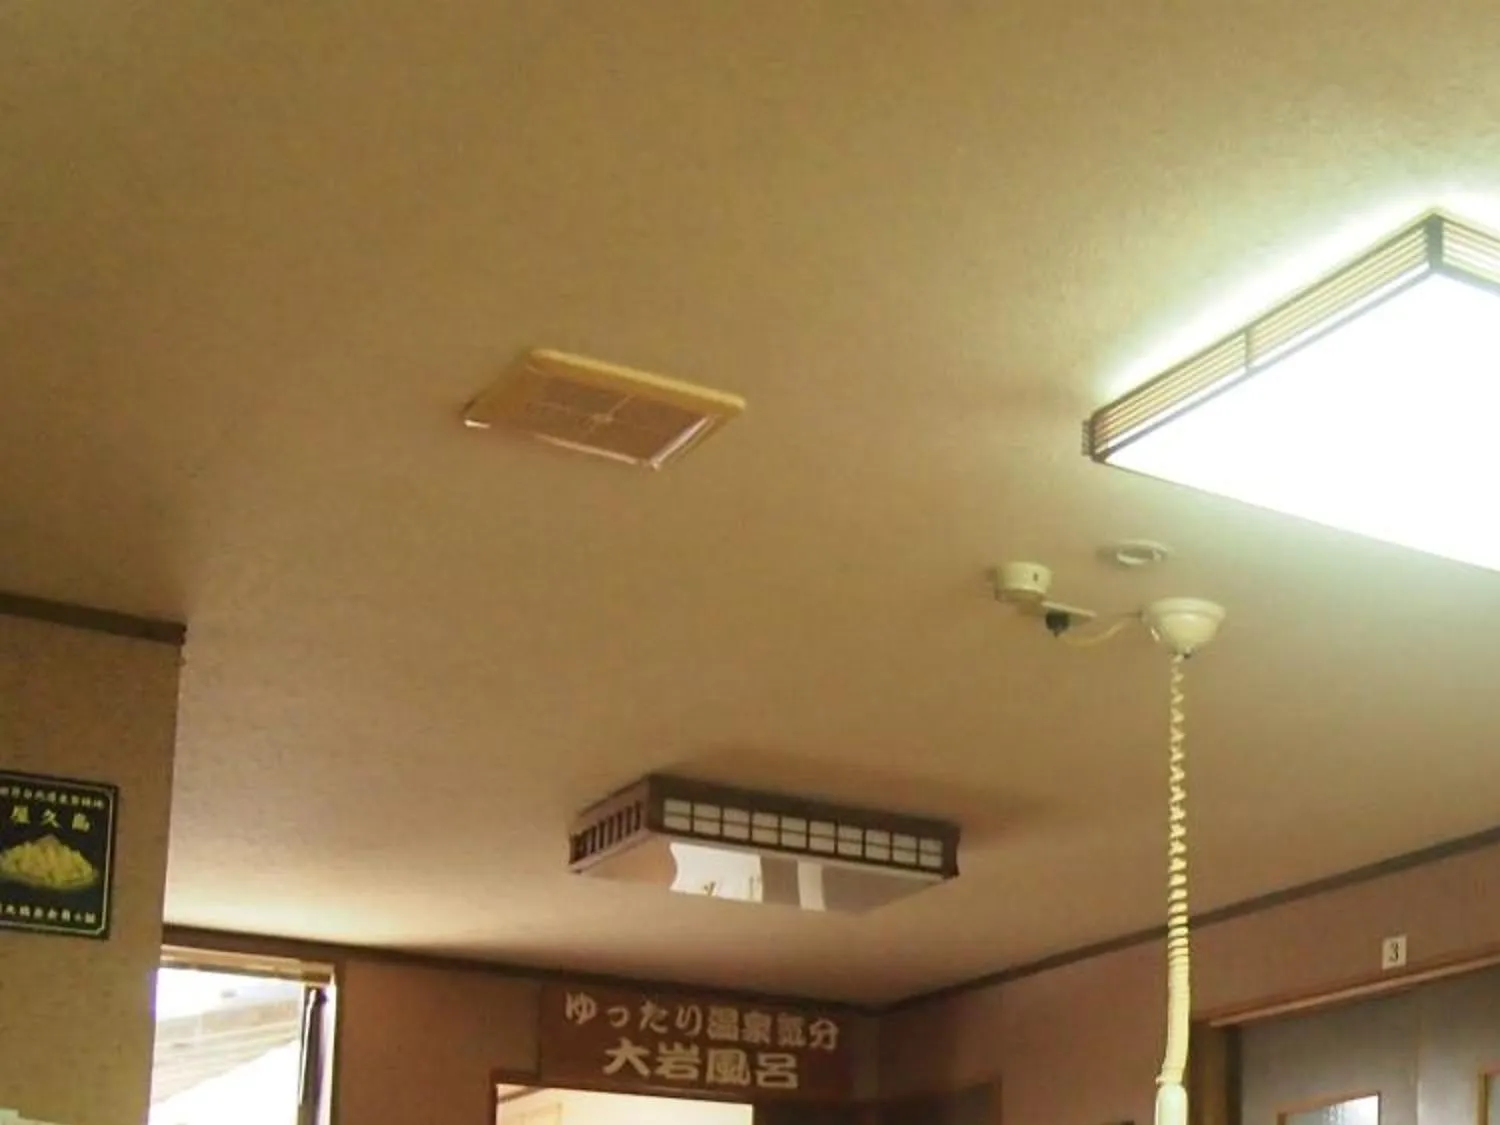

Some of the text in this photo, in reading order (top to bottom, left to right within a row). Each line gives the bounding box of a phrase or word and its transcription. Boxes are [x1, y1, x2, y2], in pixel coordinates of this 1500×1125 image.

[1390, 942, 1399, 962] 3
[603, 1037, 798, 1089] 大岩風呂
